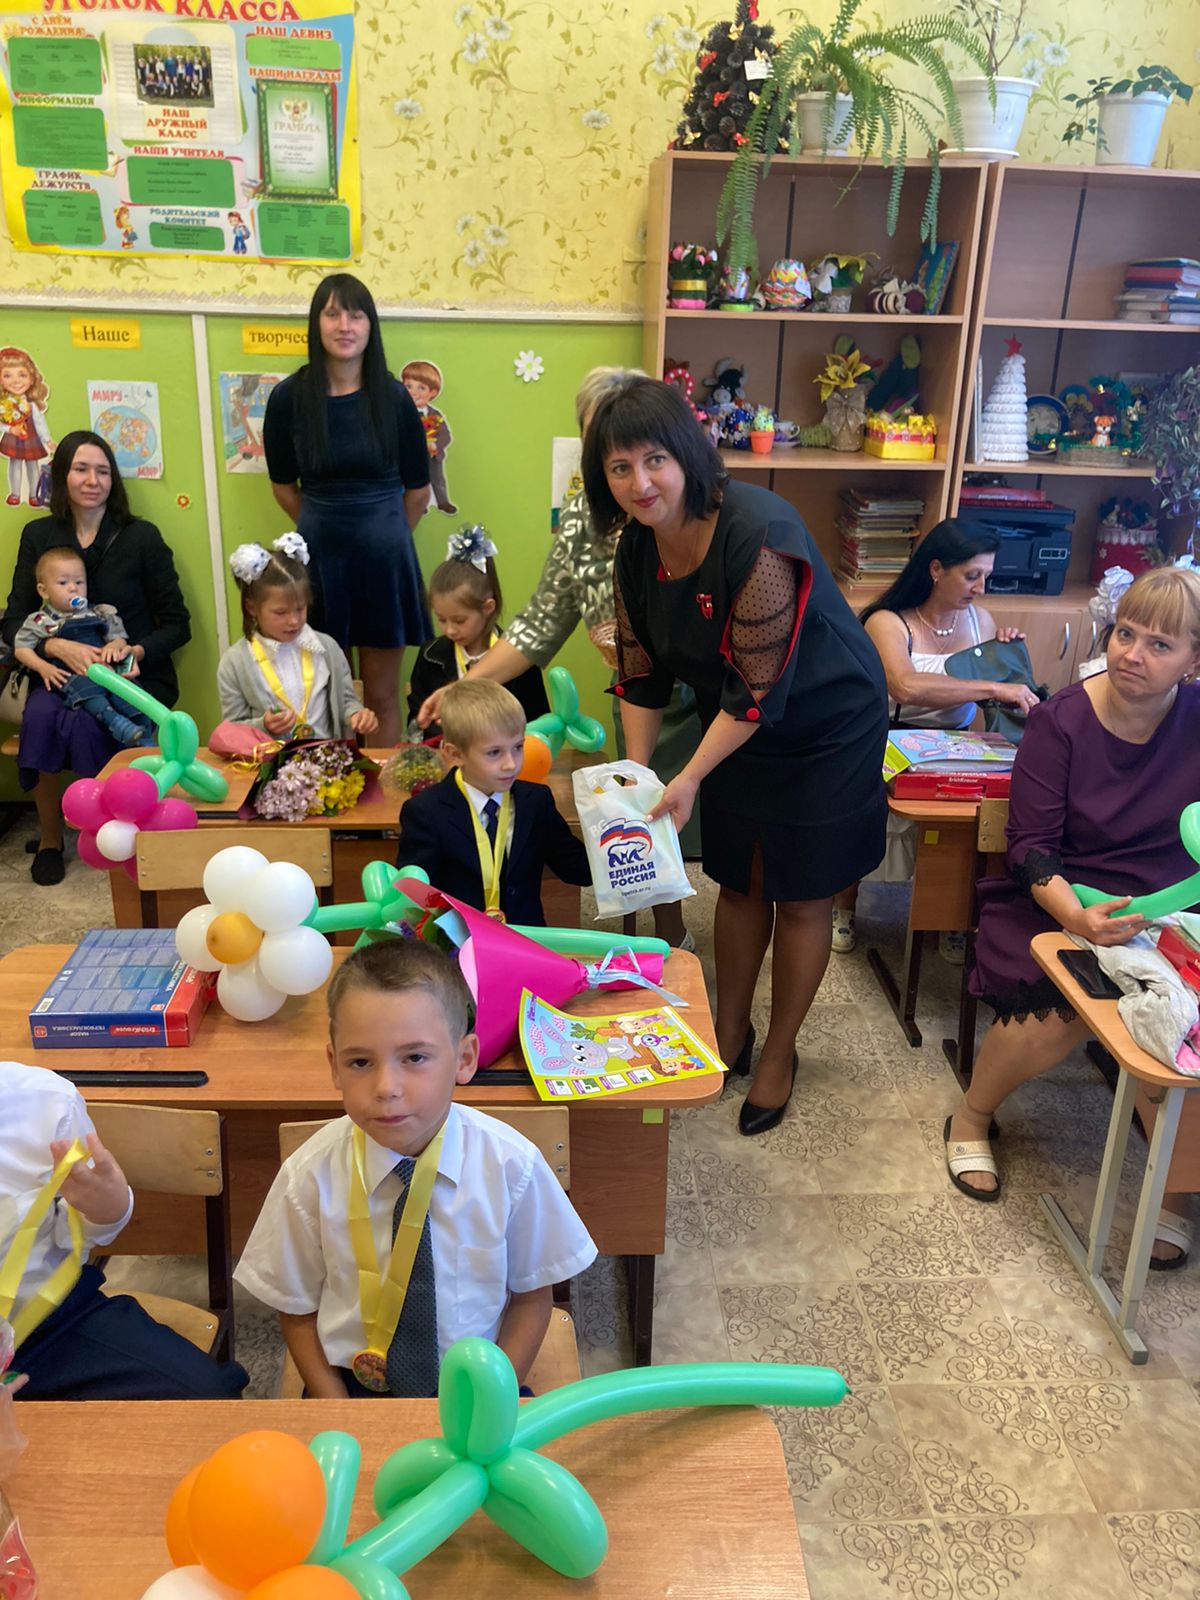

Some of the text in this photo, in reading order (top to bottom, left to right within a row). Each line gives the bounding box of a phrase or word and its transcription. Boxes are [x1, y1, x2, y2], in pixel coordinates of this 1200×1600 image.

[175, 0, 300, 21] КЛАССА
[256, 26, 332, 39] НАШ ДЕВИЗ
[249, 67, 341, 81] НАШИ НАГРАДЫ
[20, 96, 95, 106] ИНФОРМАЦИЯ
[162, 108, 190, 118] НАШ
[146, 118, 208, 129] ДРУЖНЫЙ
[274, 121, 320, 133] ГРАМОТА
[158, 129, 197, 139] КЛАСС
[134, 146, 225, 158] НАШИ УЧИТЕЛЯ
[38, 170, 82, 180] ГРАФИК
[31, 180, 91, 189] ДЕЖУРСТВ
[150, 208, 220, 218] РОДИТЕЛЬСКИЙ
[82, 326, 309, 346] Наше творчес
[609, 861, 655, 879] ЕДИНАЯ
[611, 870, 656, 888] РОССИЯ
